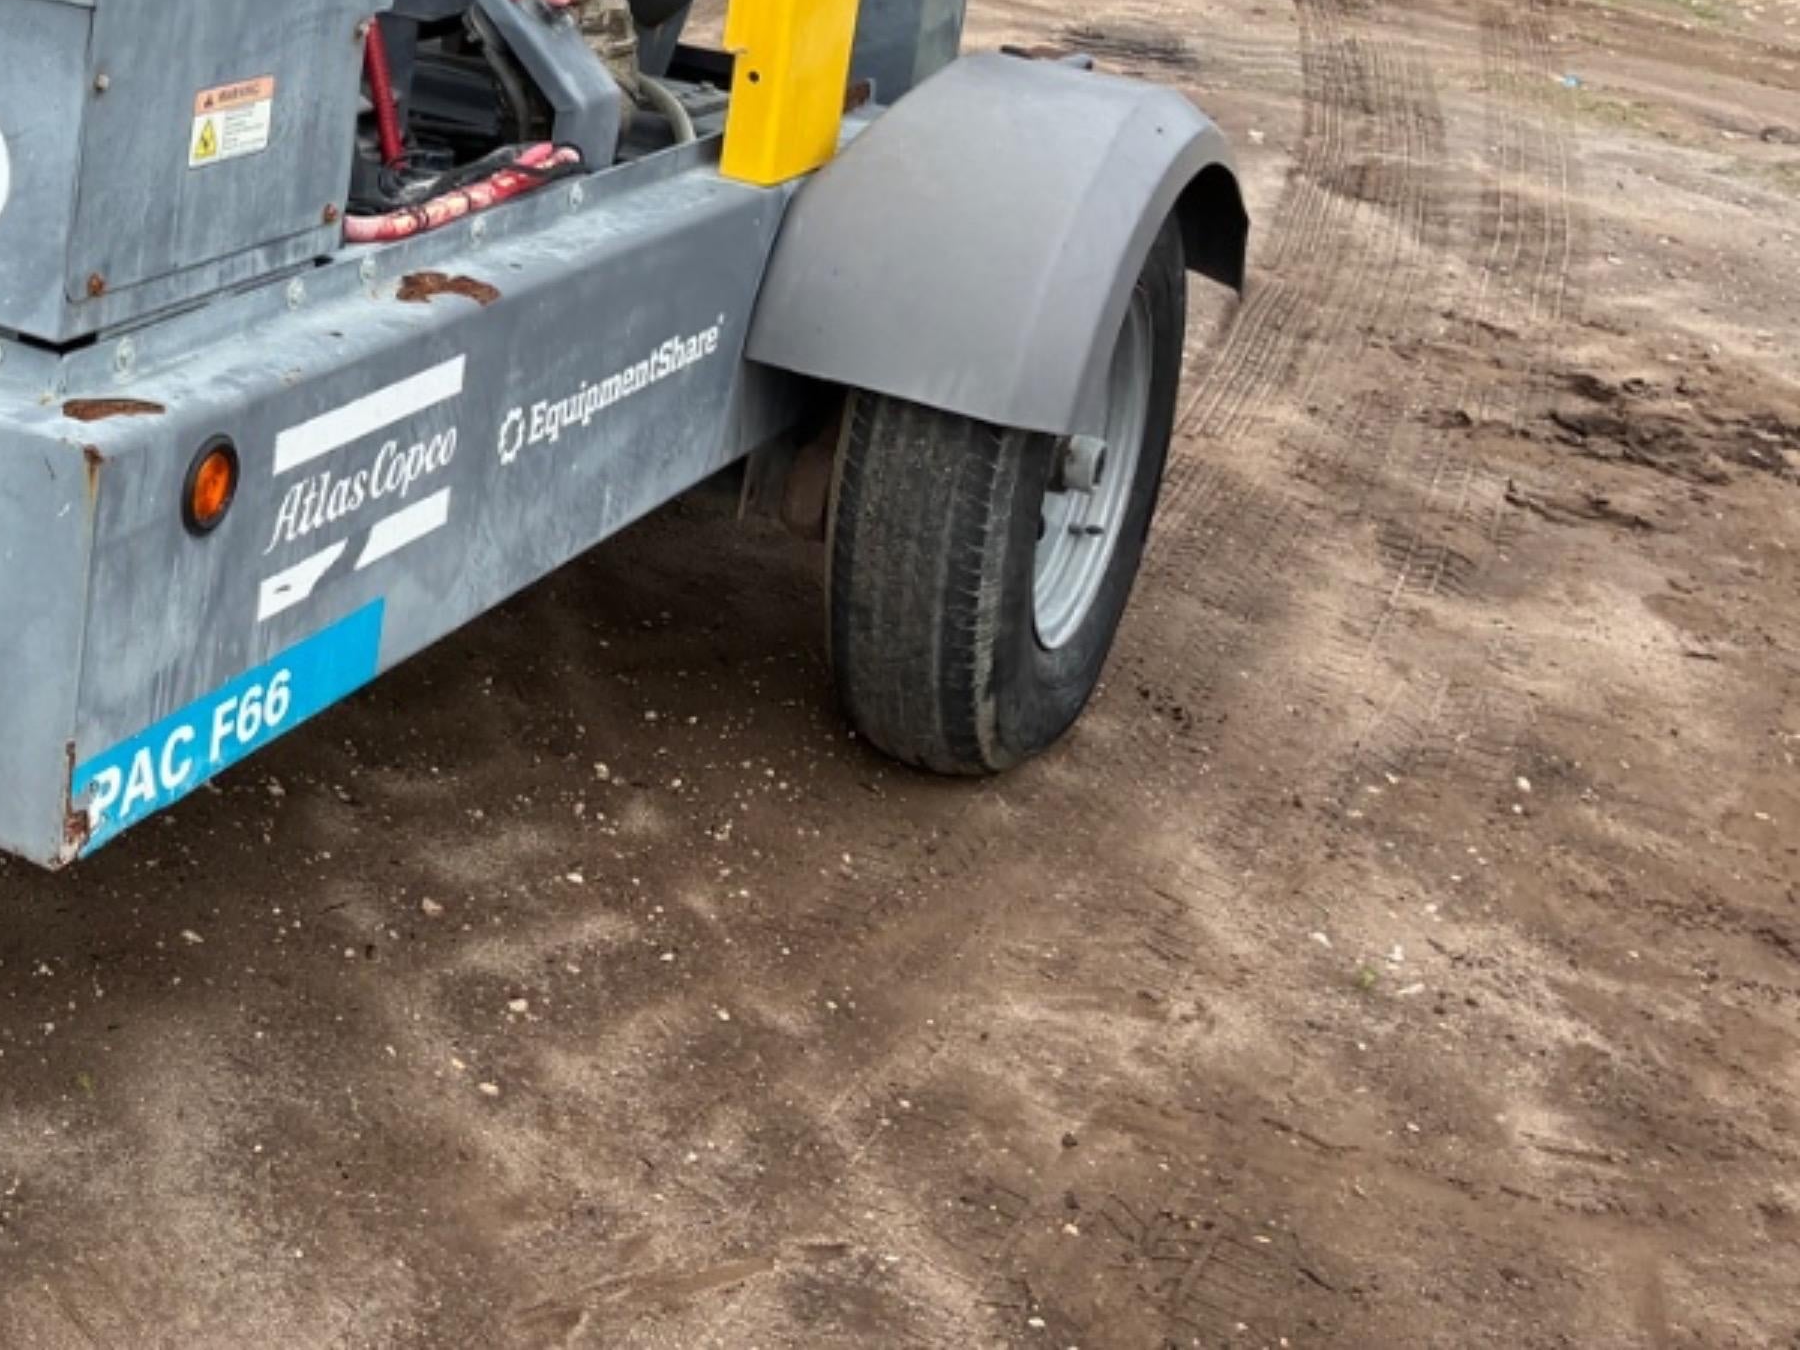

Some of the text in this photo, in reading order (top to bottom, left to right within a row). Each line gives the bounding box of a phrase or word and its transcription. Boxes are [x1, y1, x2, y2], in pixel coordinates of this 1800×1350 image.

[528, 325, 719, 444] EquipmentShare
[88, 668, 292, 836] PAC F66
